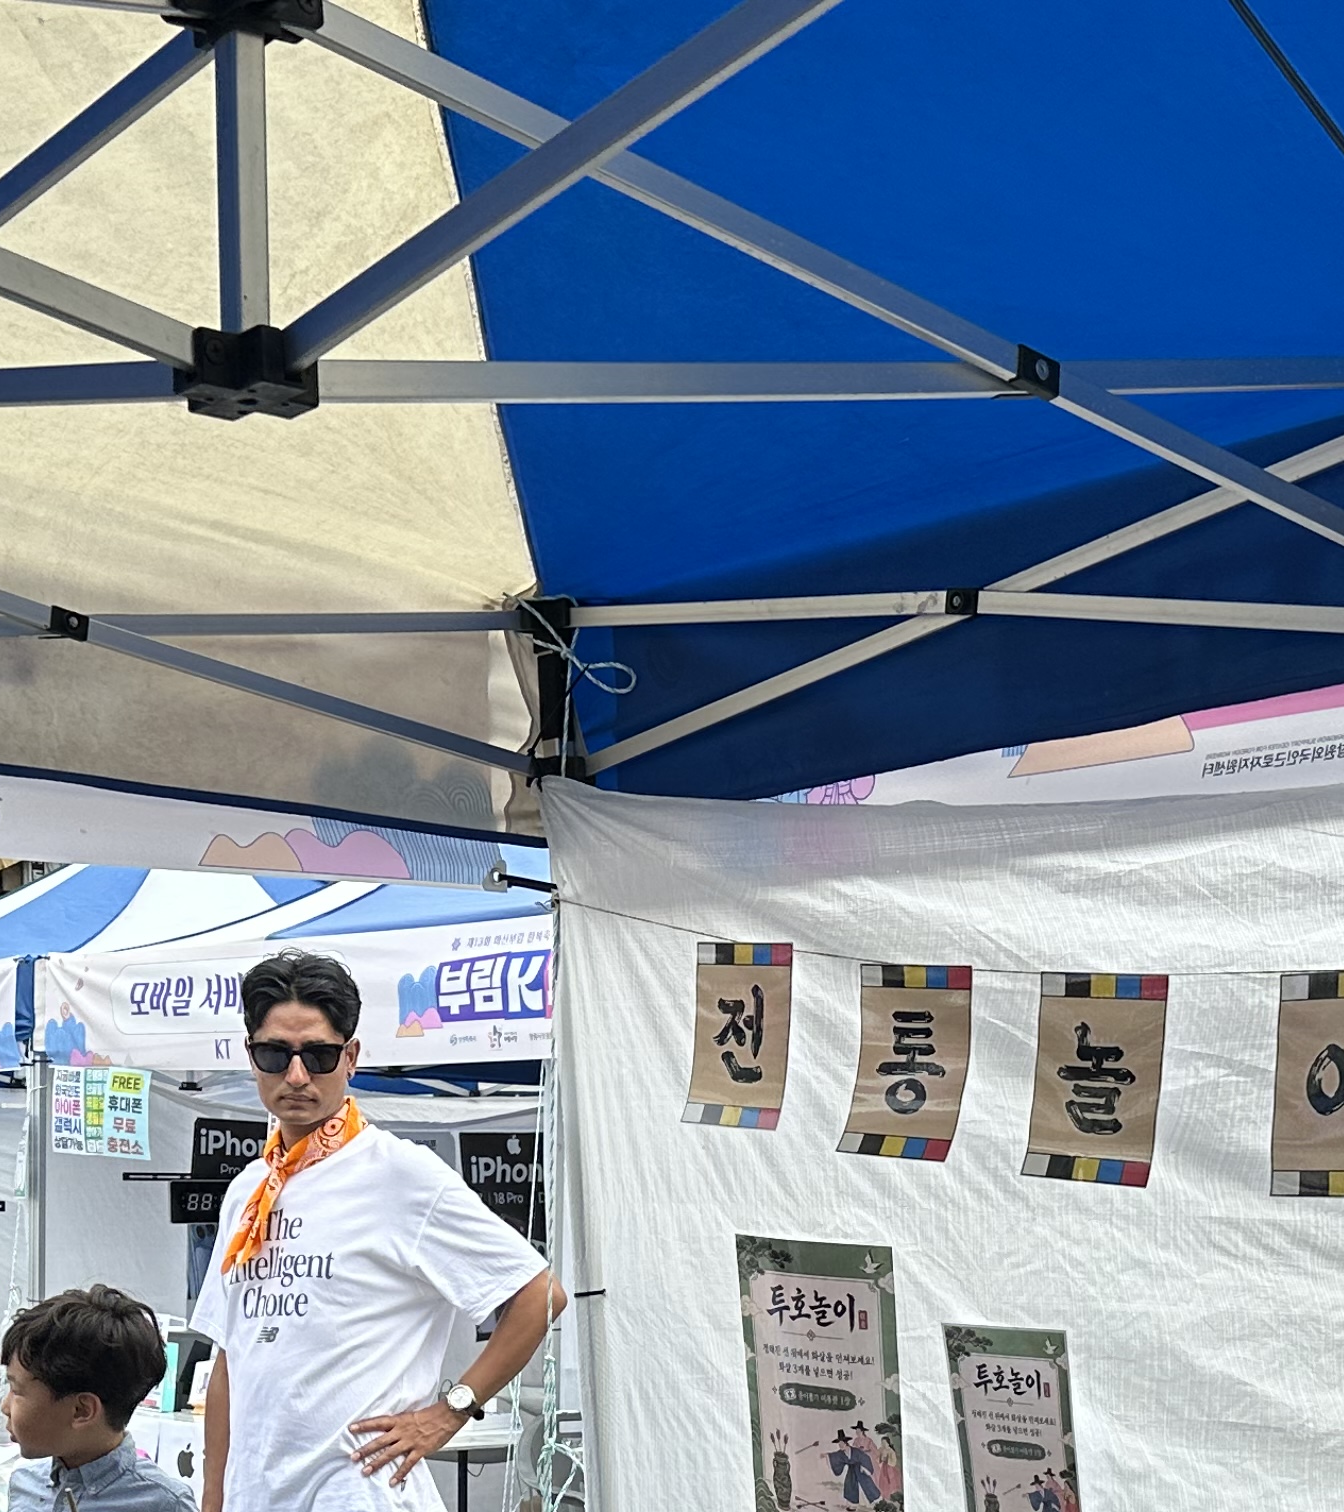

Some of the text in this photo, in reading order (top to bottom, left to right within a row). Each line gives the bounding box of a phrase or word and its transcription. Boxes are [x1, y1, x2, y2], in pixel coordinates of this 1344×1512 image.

[130, 972, 245, 1017] 모바일 서비
[215, 1039, 231, 1060] KT
[713, 983, 764, 1084] 전
[876, 1010, 947, 1115] 통
[1057, 1021, 1138, 1135] 놀
[112, 1075, 142, 1091] FREE
[55, 1098, 81, 1117] 아이폰
[108, 1095, 143, 1114] 휴대폰
[54, 1116, 82, 1136] 갤럭시
[112, 1116, 136, 1134] 무료
[107, 1136, 145, 1156] 충전소
[470, 1155, 544, 1184] iPhon
[506, 1192, 524, 1205] Pro
[264, 1208, 302, 1242] The
[243, 1286, 308, 1319] Choice
[767, 1284, 856, 1333] 투호놀이
[973, 1364, 1041, 1400] 투호놀이
